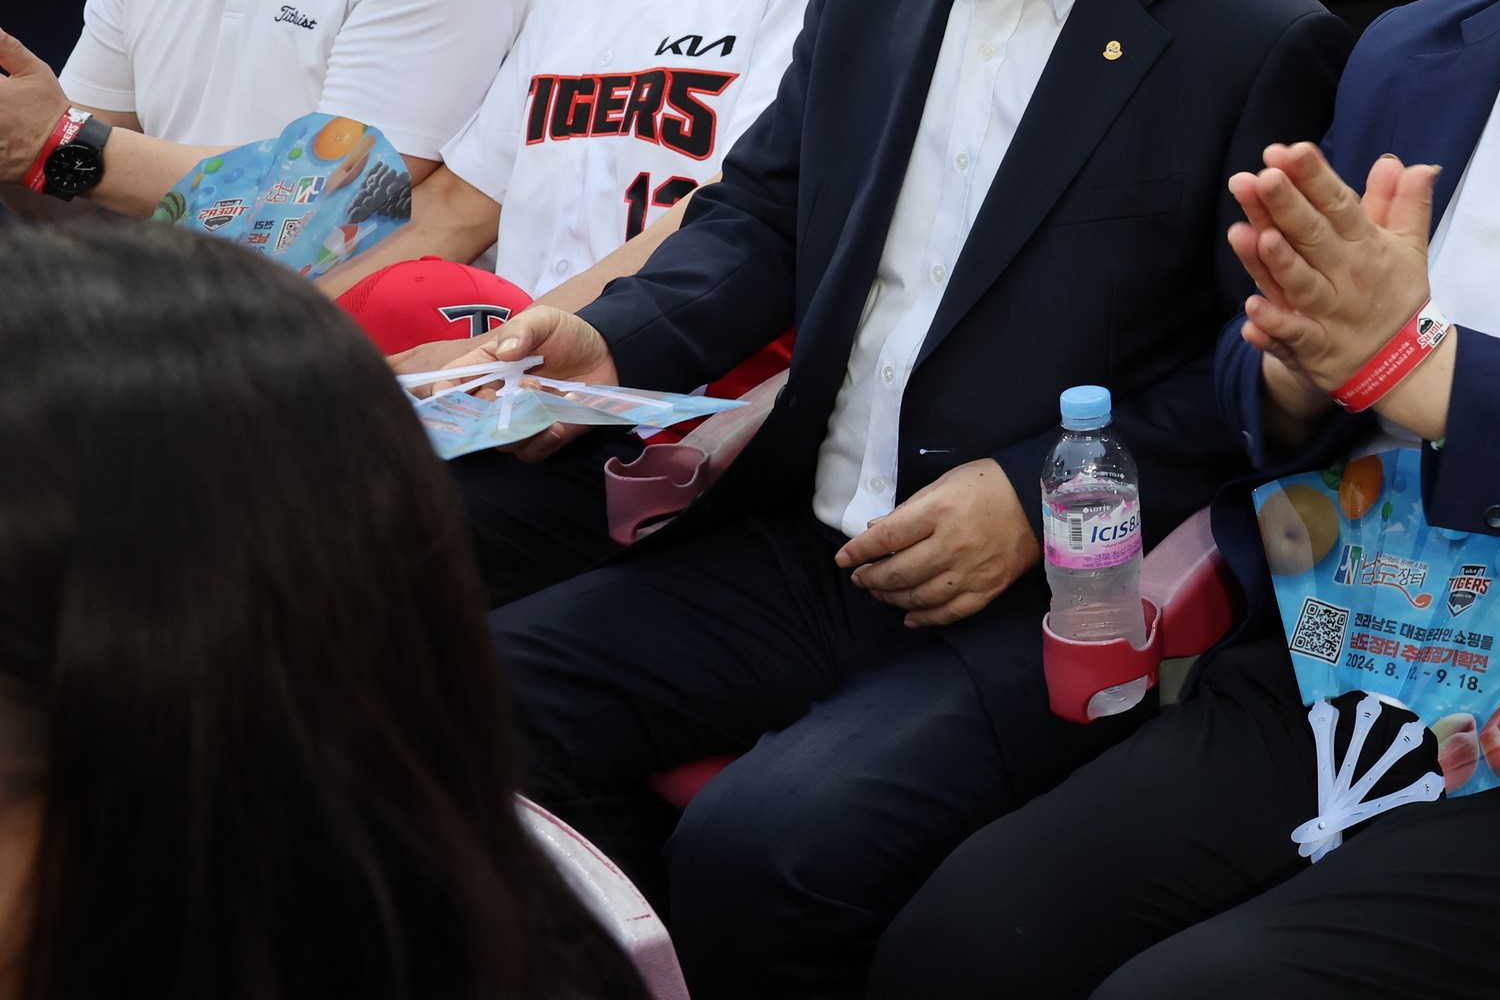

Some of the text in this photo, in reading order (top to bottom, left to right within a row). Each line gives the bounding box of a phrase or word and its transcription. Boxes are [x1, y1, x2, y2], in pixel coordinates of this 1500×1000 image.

[526, 67, 740, 161] IGERS
[1091, 520, 1128, 543] ICIS
[1449, 577, 1492, 595] TIGERS
[1350, 632, 1399, 658] 남도장터
[1355, 613, 1493, 651] 전라남도 대표 온라인 쇼핑몰
[1346, 653, 1378, 674] 2024.
[1385, 662, 1399, 679] 8.
[1437, 669, 1450, 686] 9.
[1459, 674, 1483, 693] 18.
